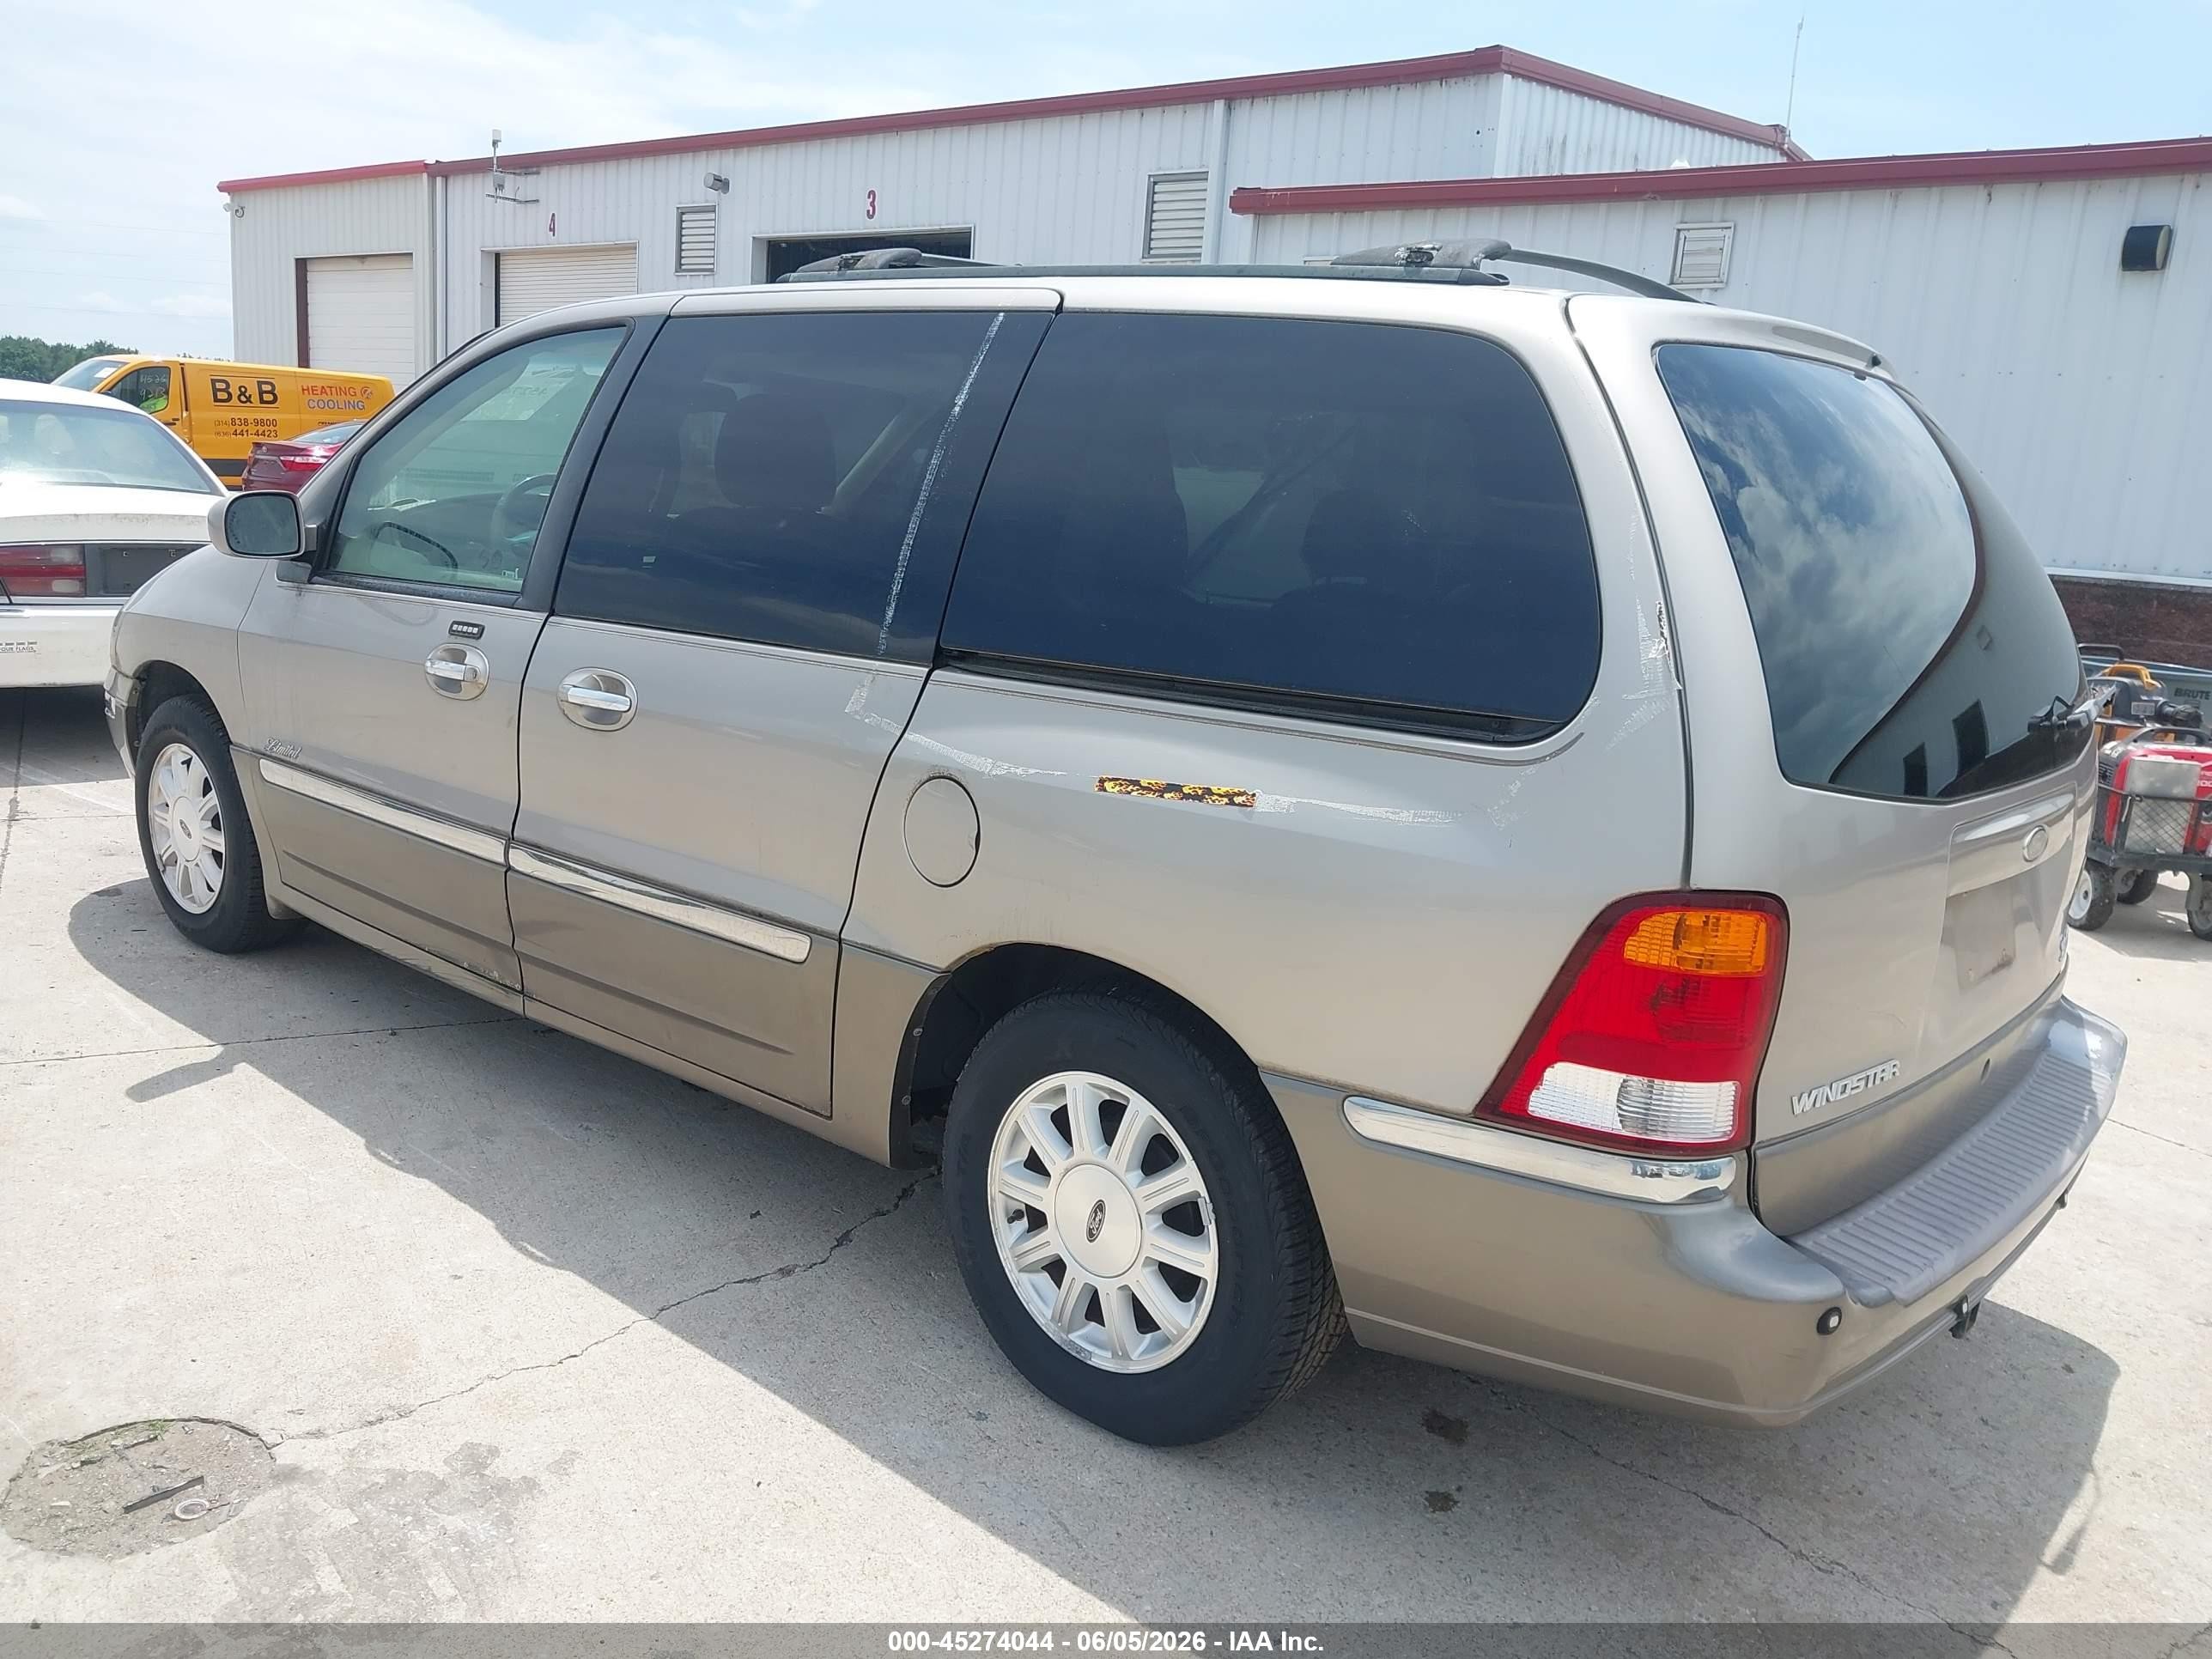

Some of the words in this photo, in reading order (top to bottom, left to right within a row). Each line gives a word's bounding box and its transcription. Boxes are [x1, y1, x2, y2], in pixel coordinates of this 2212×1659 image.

[866, 189, 876, 220] 3
[549, 212, 556, 237] 4
[301, 385, 356, 397] HEATING
[307, 398, 365, 410] COOLING
[2174, 687, 2211, 701] BRUTE
[1791, 1058, 1900, 1116] WINDSTAR
